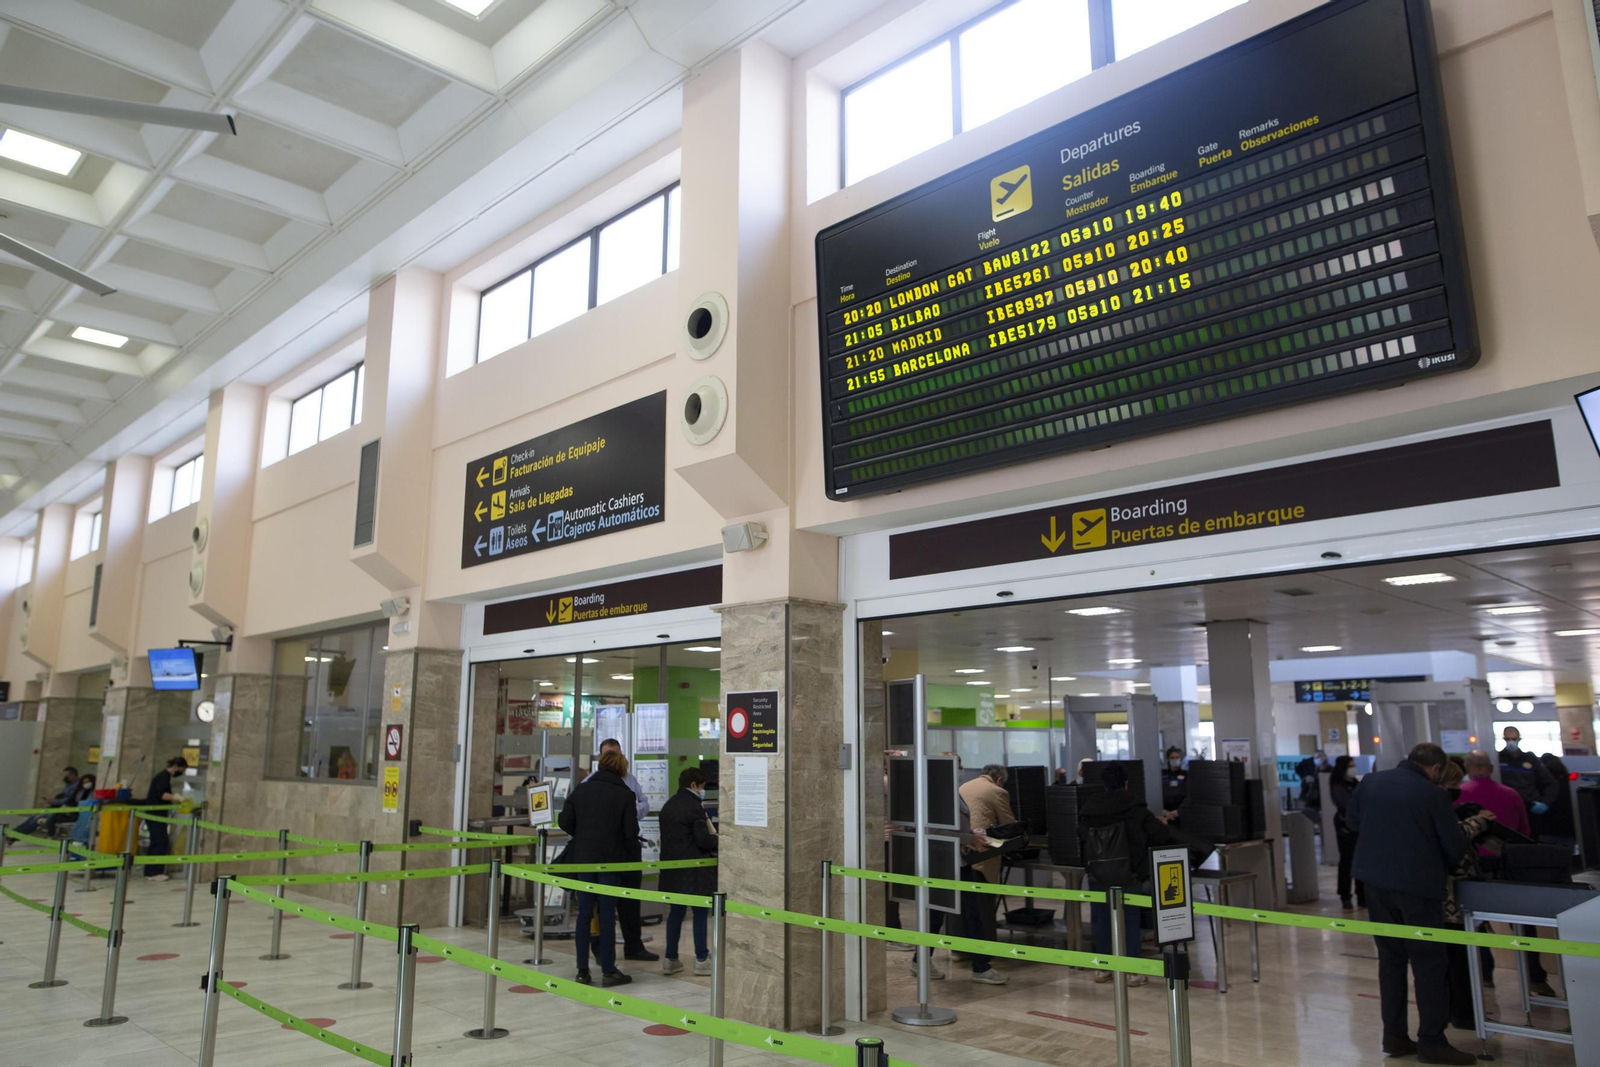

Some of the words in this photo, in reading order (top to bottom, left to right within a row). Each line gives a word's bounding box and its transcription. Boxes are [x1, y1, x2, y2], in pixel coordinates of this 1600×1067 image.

[1239, 118, 1280, 139] Remarks
[1240, 115, 1320, 151] Observaciones
[1060, 121, 1141, 164] Departures
[1197, 141, 1218, 155] Gate
[1198, 148, 1232, 167] Puerta
[1062, 159, 1120, 191] Salidas
[1128, 162, 1165, 182] Boarding
[1130, 169, 1178, 194] Embarque
[1065, 190, 1094, 207] Counter
[1066, 195, 1109, 218] Mostrador
[977, 227, 996, 241] Flight
[978, 237, 1000, 251] Vuelo
[843, 301, 882, 326] 20:20
[889, 280, 940, 309] LONDON
[947, 268, 973, 288] GAT
[983, 239, 1051, 276] BAW8122
[1125, 191, 1182, 225] 19:40
[885, 258, 917, 277] Destination
[840, 283, 854, 294] Time
[844, 323, 883, 347] 21:05
[890, 303, 941, 332] BILBAO
[984, 265, 1051, 300] IBE5261
[1127, 218, 1185, 251] 20:25
[886, 271, 911, 286] Destino
[840, 293, 855, 304] Hora
[845, 346, 884, 370] 21:20
[891, 327, 942, 355] MADRID
[986, 290, 1054, 325] IBE8937
[1129, 246, 1188, 278] 20:40
[846, 368, 886, 391] 21:55
[893, 342, 971, 377] BARCELONA
[987, 315, 1057, 348] IBE5179
[1132, 272, 1191, 304] 21:15
[1431, 353, 1456, 365] IKUSI
[509, 455, 554, 480] Facturación
[555, 449, 566, 463] de
[568, 436, 606, 460] Equipaje
[510, 448, 535, 465] Check-in
[508, 499, 525, 515] Sala
[527, 495, 537, 508] de
[538, 485, 574, 506] Llegadas
[509, 484, 531, 500] Arrivals
[563, 500, 606, 522] Automatic
[608, 491, 644, 512] Cashiers
[1110, 497, 1188, 523] Boarding
[507, 522, 527, 537] Toilets
[563, 518, 596, 539] Cajeros
[597, 502, 660, 530] Automáticos
[1111, 523, 1175, 545] Puertas
[1178, 517, 1201, 536] de
[1204, 504, 1306, 532] embarque
[506, 535, 528, 550] Aseos
[574, 593, 605, 607] Boarding
[573, 608, 599, 621] Puertas
[599, 607, 609, 617] de
[609, 602, 648, 616] embarque
